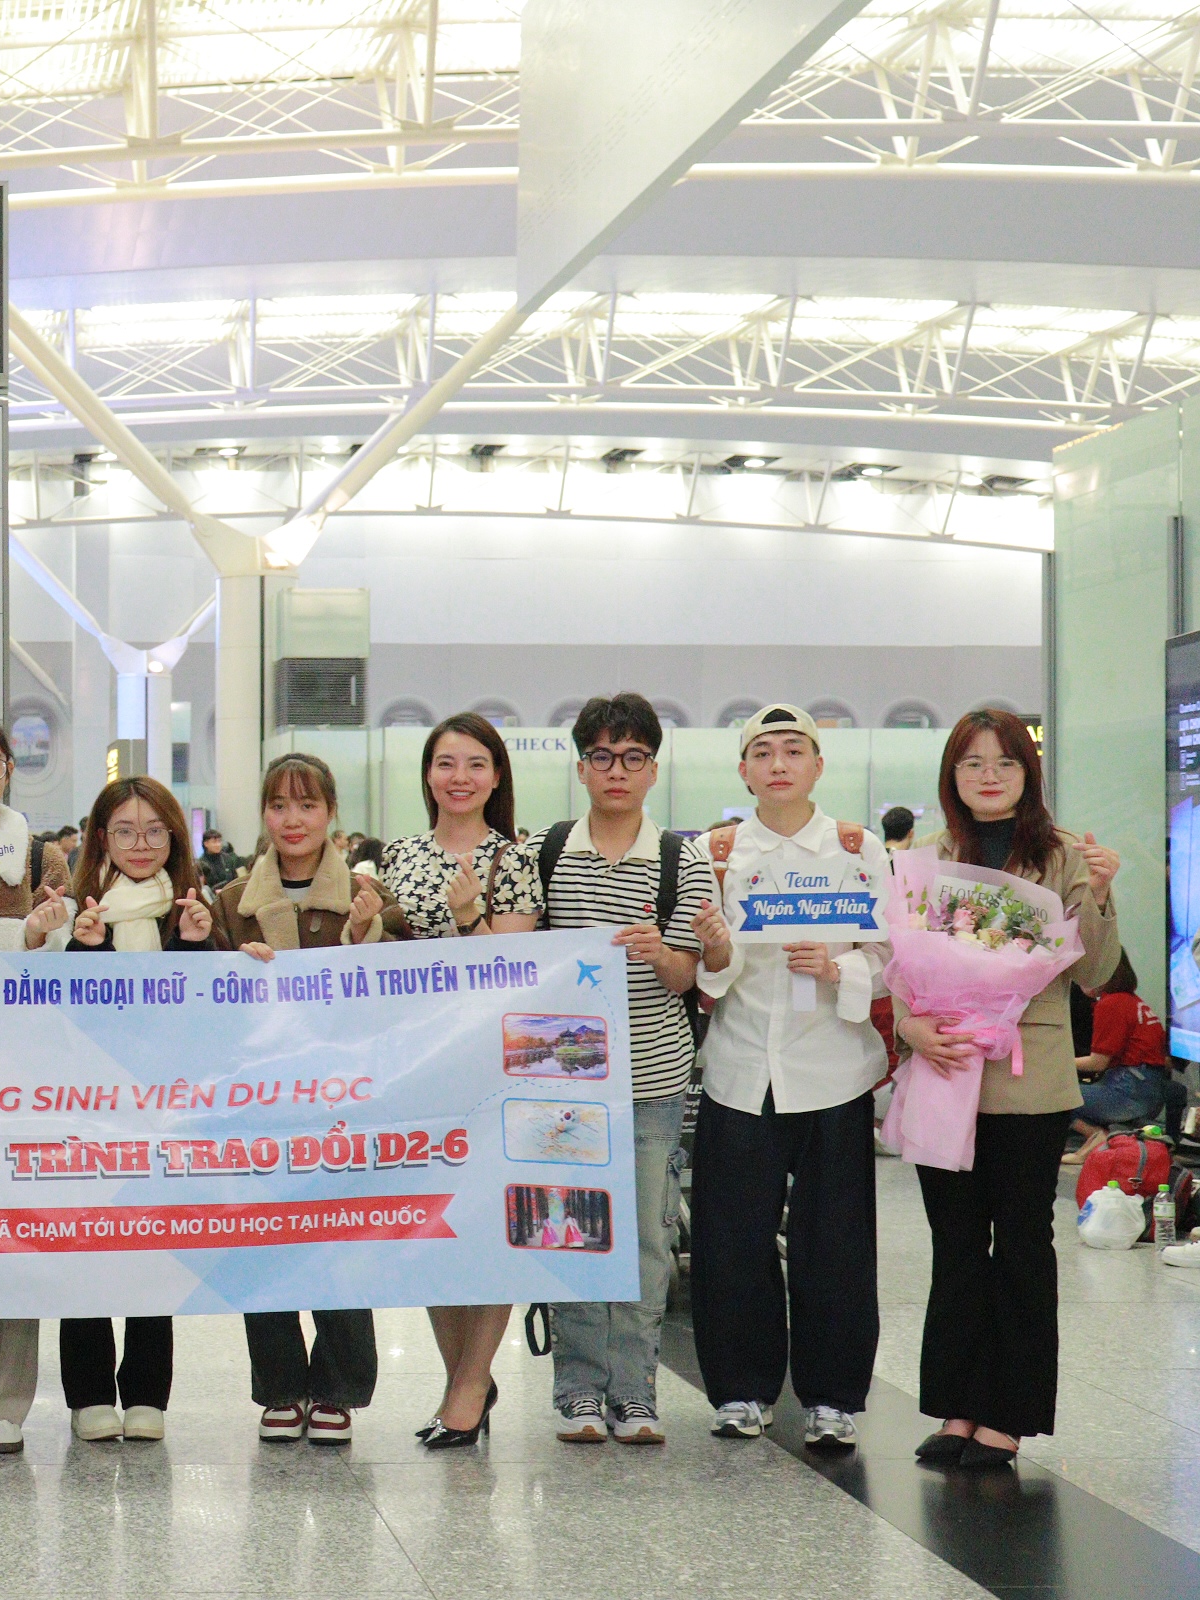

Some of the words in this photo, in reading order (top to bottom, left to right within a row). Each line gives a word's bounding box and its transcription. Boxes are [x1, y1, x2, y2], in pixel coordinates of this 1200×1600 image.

[504, 737, 567, 751] CHECK
[784, 871, 830, 888] Team
[753, 900, 795, 920] Ngôn
[797, 899, 832, 919] Ngữ
[834, 898, 870, 914] Hàn
[3, 968, 61, 1005] ĐẲNG
[70, 978, 134, 1010] NGOẠI
[142, 971, 188, 1005] NGỮ
[212, 970, 269, 1004] CÔNG
[277, 968, 334, 1005] NGHỆ
[340, 965, 370, 999] VÀ
[376, 960, 459, 996] TRUYỀN
[465, 955, 539, 990] THÔNG
[31, 1085, 119, 1111] SINH
[131, 1078, 218, 1110] VIÊN
[227, 1080, 281, 1108] DU
[292, 1076, 374, 1110] HỌC
[5, 1135, 151, 1181] TRÌNH
[157, 1136, 281, 1178] TRAO
[287, 1120, 368, 1174] ĐỔI
[373, 1128, 470, 1170] D2-6
[15, 1222, 76, 1242] CHẠM
[81, 1216, 115, 1237] TỚI
[119, 1216, 166, 1236] ƯỚC
[170, 1218, 203, 1235] MƠ
[208, 1218, 236, 1234] DU
[240, 1215, 283, 1236] HỌC
[288, 1214, 319, 1233] TẠI
[323, 1208, 364, 1228] HÀN
[369, 1205, 427, 1228] QUỐC
